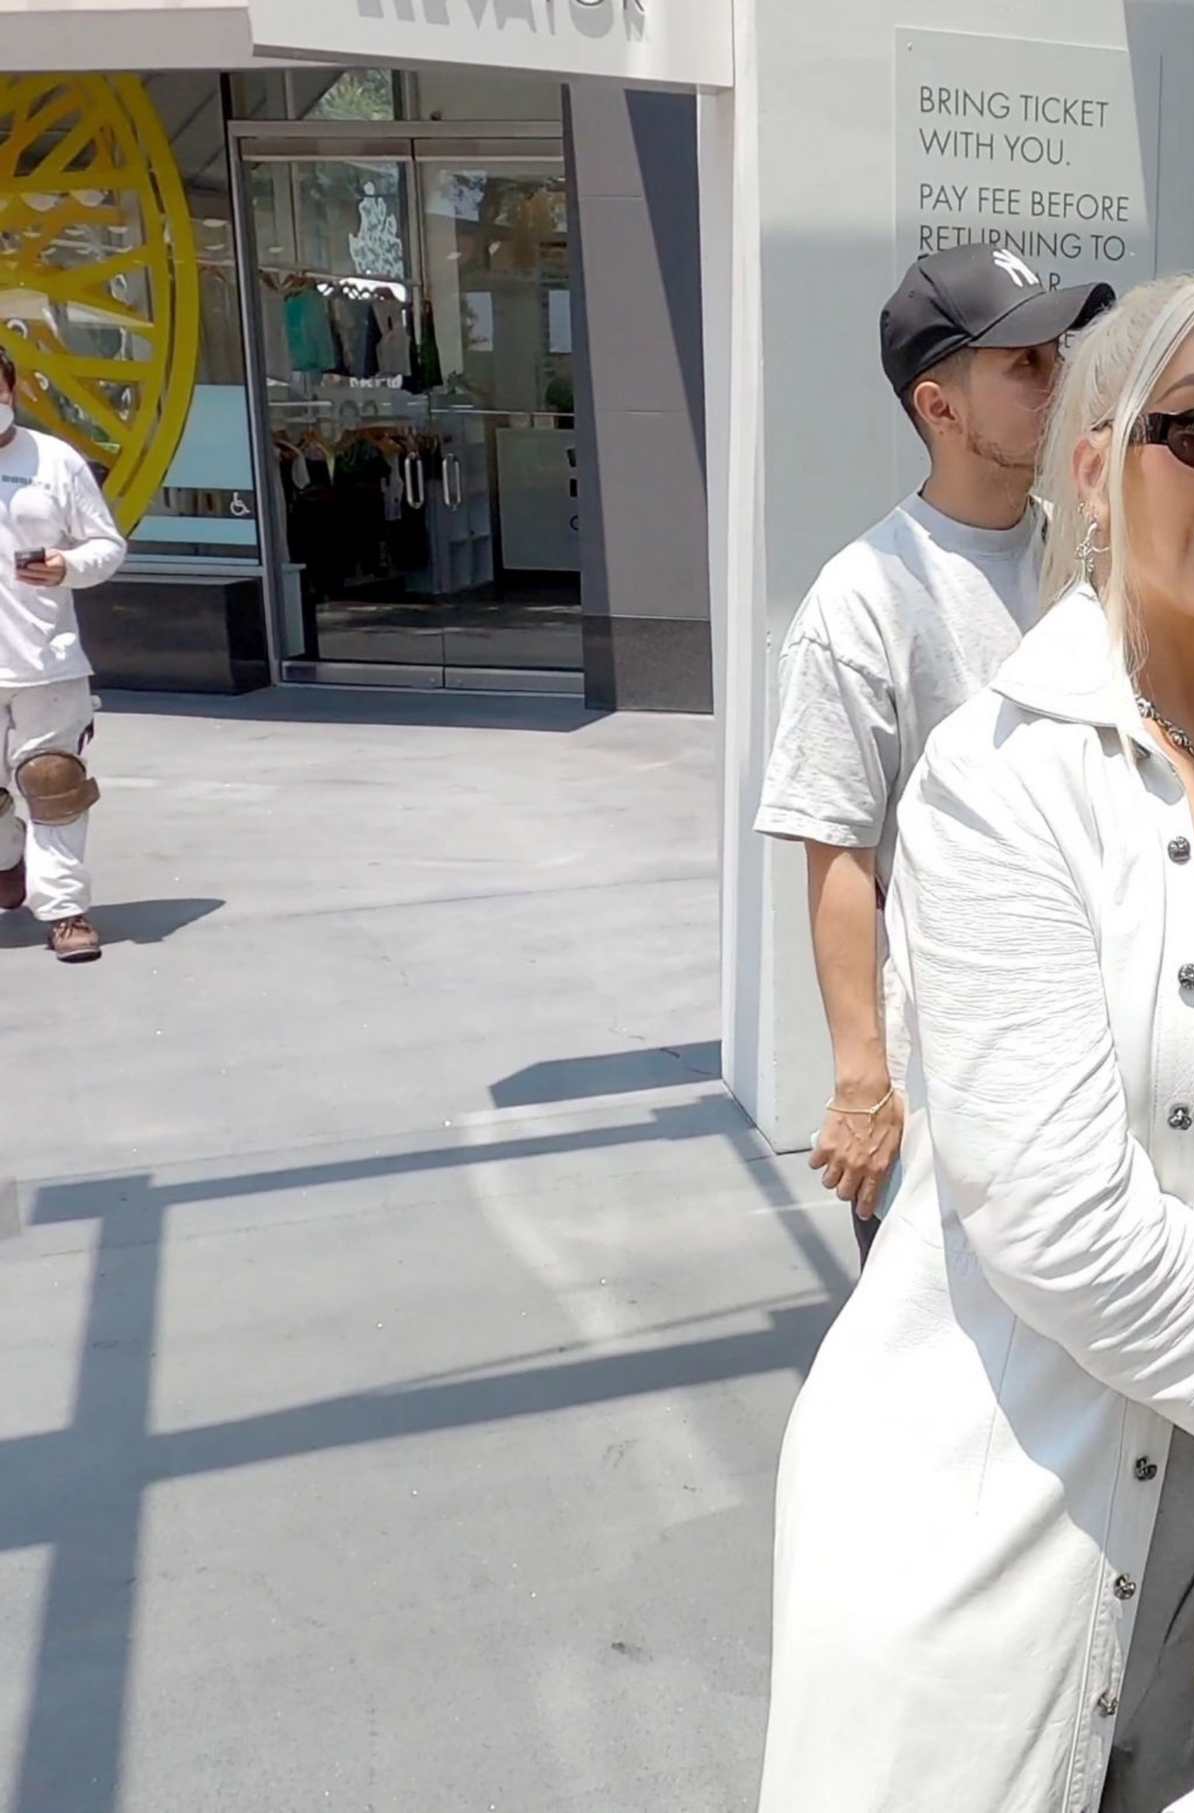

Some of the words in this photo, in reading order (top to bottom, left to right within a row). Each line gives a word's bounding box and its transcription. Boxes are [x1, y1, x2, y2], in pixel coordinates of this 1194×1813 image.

[919, 85, 1011, 119] BRING
[1019, 94, 1109, 127] TICKET
[918, 128, 994, 160] WITH
[1003, 135, 1071, 166] YOU.
[919, 183, 968, 212] PAY
[978, 187, 1021, 215] FEE
[1031, 191, 1129, 222] BEFORE
[1090, 234, 1126, 261] TO
